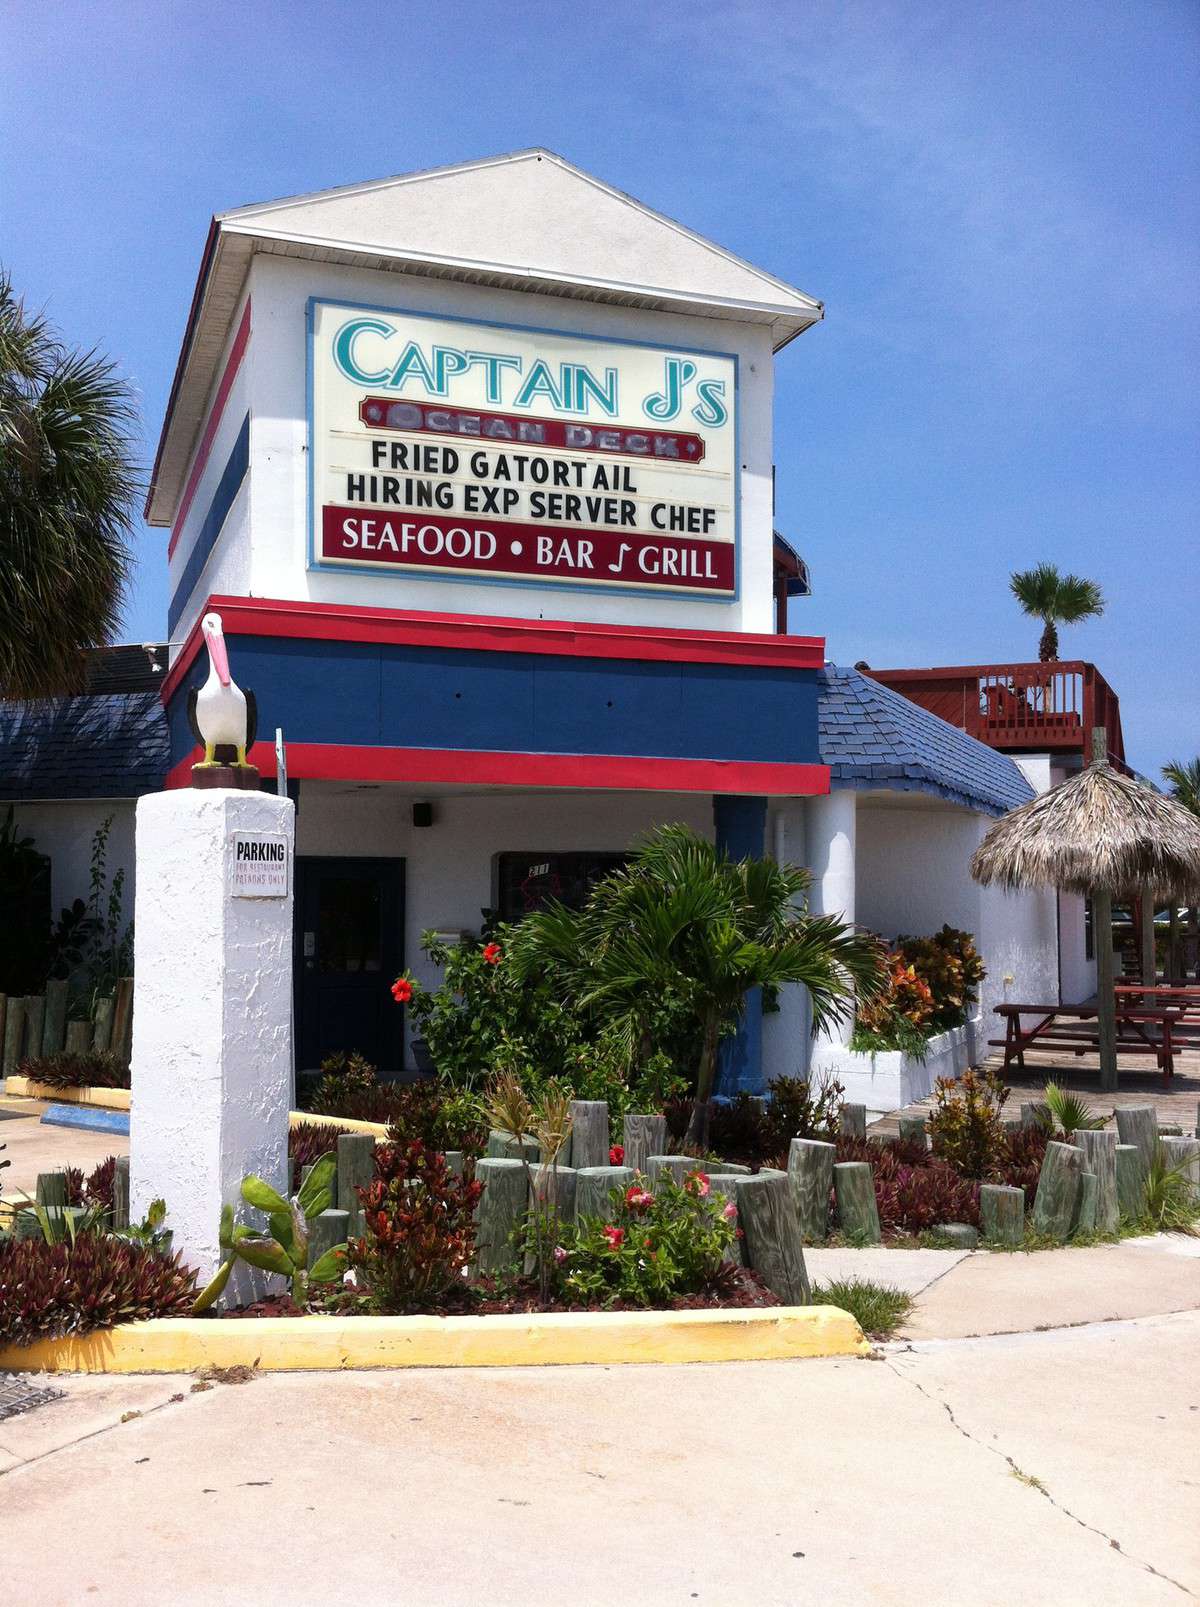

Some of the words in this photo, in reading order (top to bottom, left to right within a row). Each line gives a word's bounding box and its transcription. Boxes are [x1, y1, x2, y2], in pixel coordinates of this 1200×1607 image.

[334, 317, 618, 416] CAPTAIN
[642, 357, 728, 427] J'S
[386, 403, 545, 442] OCEAN
[566, 425, 680, 457] DECK
[372, 441, 459, 474] FRIED
[347, 474, 454, 509] HIRING
[464, 486, 520, 515] EXP
[530, 491, 637, 527] SERVER
[650, 503, 716, 534] CHEF
[342, 519, 497, 560] SEAFOOD
[536, 537, 594, 569] BAR
[638, 547, 718, 578] GRILL
[237, 842, 285, 861] PARKING
[269, 874, 285, 884] ONLY
